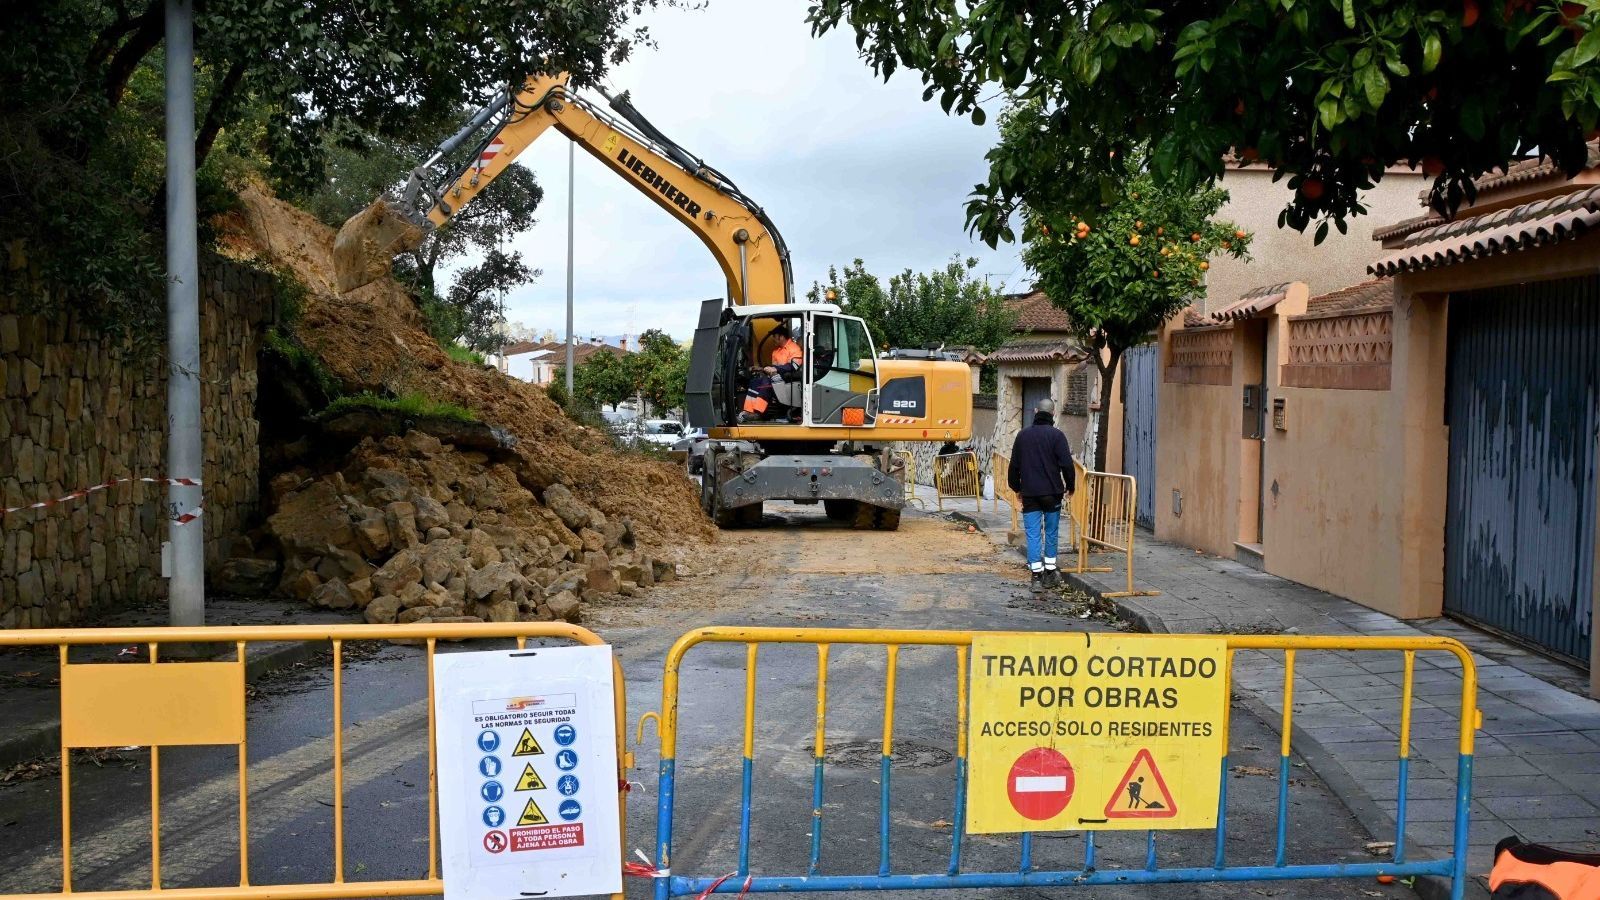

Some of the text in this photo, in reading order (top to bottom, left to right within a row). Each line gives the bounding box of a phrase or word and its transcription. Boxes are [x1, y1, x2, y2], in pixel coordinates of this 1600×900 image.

[616, 148, 702, 220] LIEBHERR
[893, 400, 916, 408] 920
[982, 655, 1217, 679] TRAMO CORTADO
[1019, 686, 1178, 709] POR OBRAS
[484, 713, 528, 722] OBLIGATORIO
[554, 708, 576, 716] TODAS
[495, 719, 522, 728] NORMAS
[534, 716, 571, 725] SEGURIDAD
[981, 721, 1212, 737] ACCESO SOLO RESIDENTES
[512, 828, 550, 837] PROHIBIDO
[562, 825, 581, 833] PASO
[544, 832, 577, 840] PERSONA
